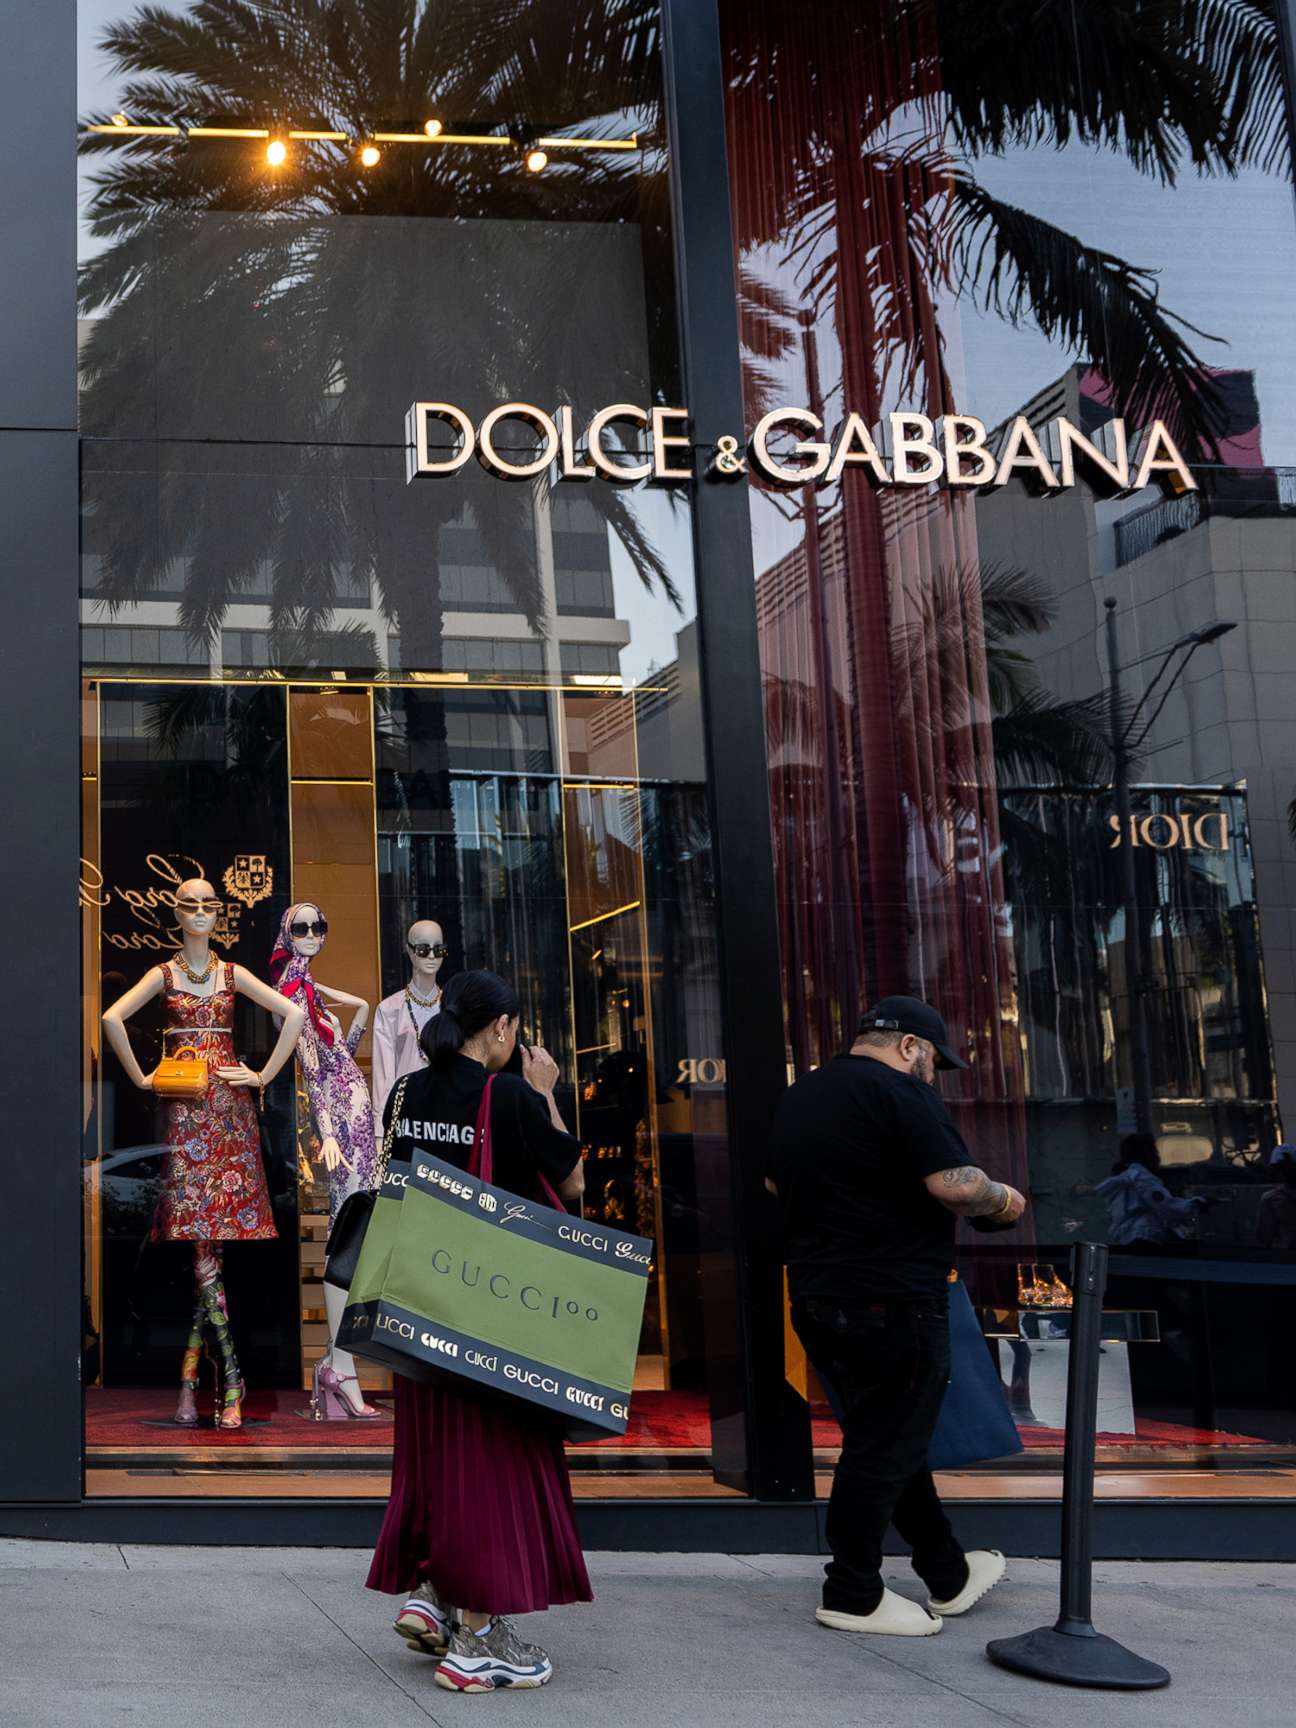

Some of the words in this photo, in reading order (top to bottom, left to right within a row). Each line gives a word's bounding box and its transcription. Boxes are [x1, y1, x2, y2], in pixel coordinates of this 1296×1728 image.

[407, 401, 694, 485] DOLCE
[714, 434, 749, 475] &
[750, 406, 1197, 496] GABBANA
[558, 1225, 608, 1253] GUCCI
[503, 1364, 560, 1396] GUCCI
[566, 1385, 605, 1412] GUCCI
